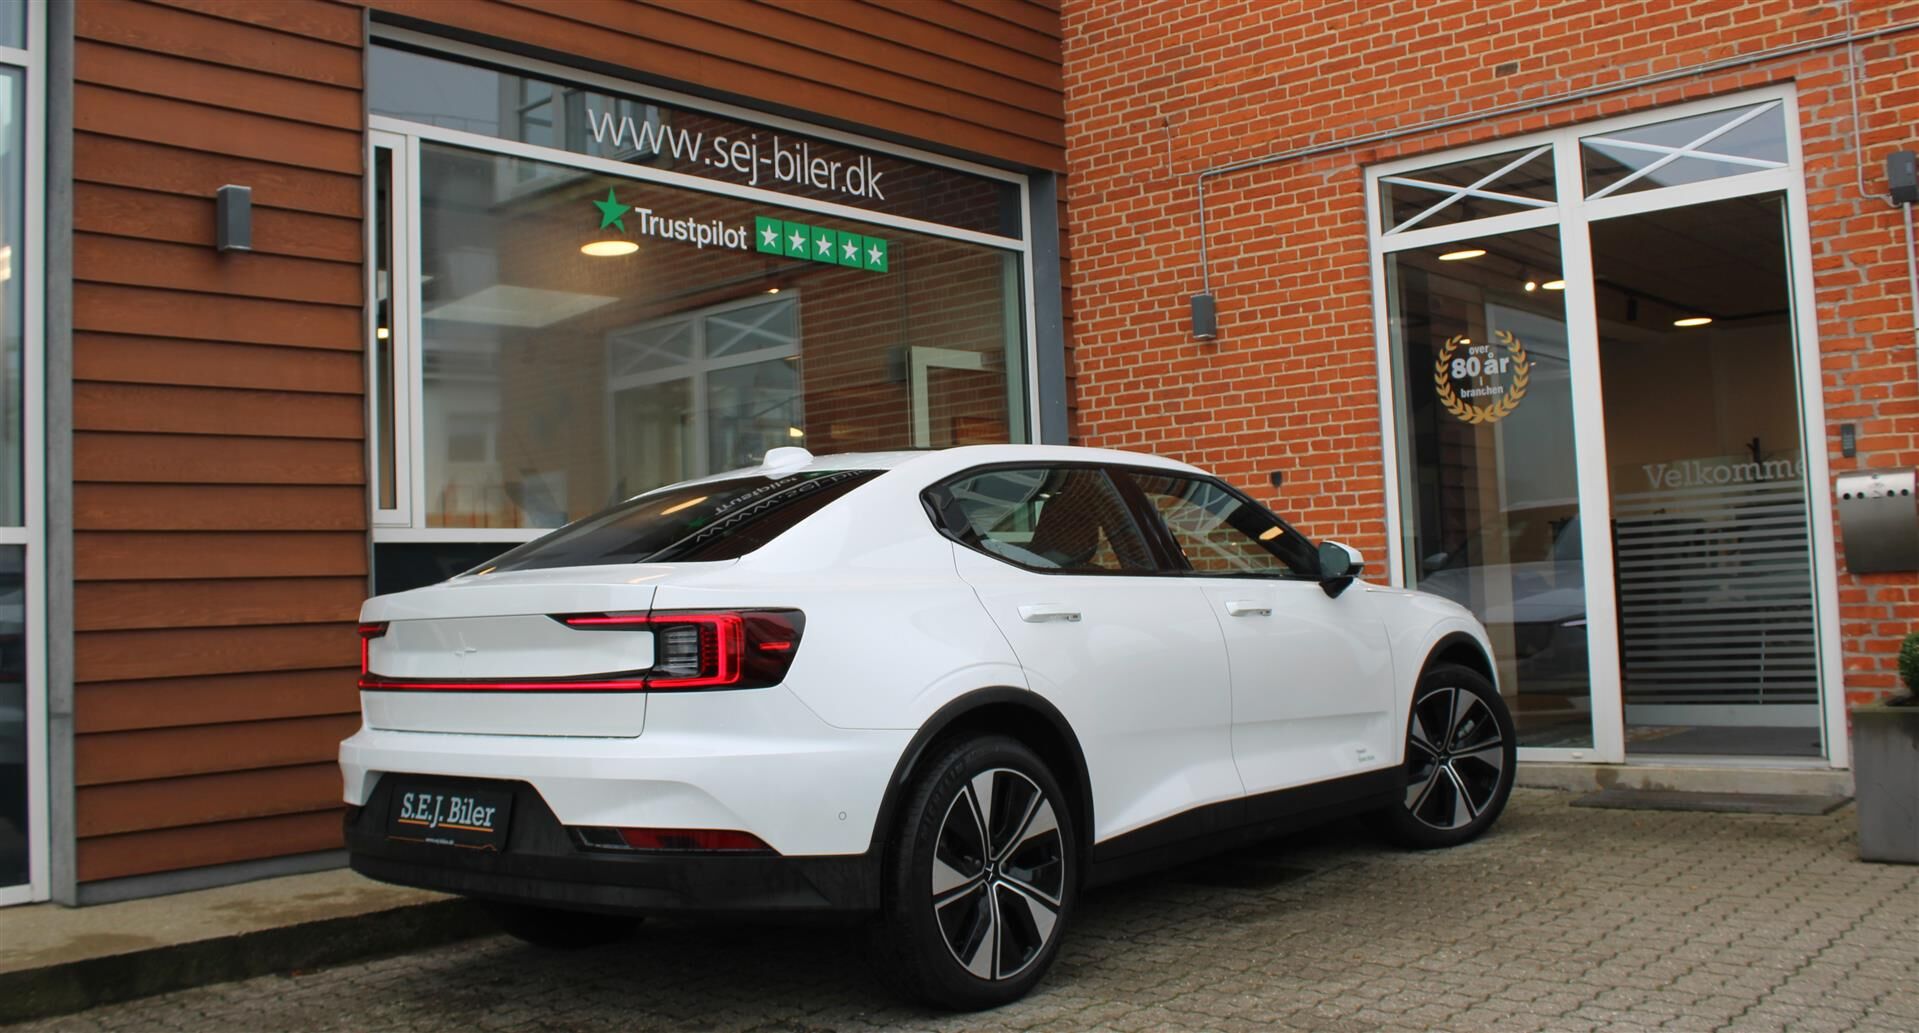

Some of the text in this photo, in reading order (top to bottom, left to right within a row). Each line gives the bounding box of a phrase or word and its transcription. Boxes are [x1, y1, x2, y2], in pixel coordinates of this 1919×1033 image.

[588, 108, 885, 200] www.sej-biler.dk
[634, 206, 748, 250] Trustpilot
[1451, 352, 1510, 379] 80 år
[1468, 345, 1489, 355] over
[1460, 385, 1504, 398] branchen
[400, 792, 496, 828] S.E.J. Biler
